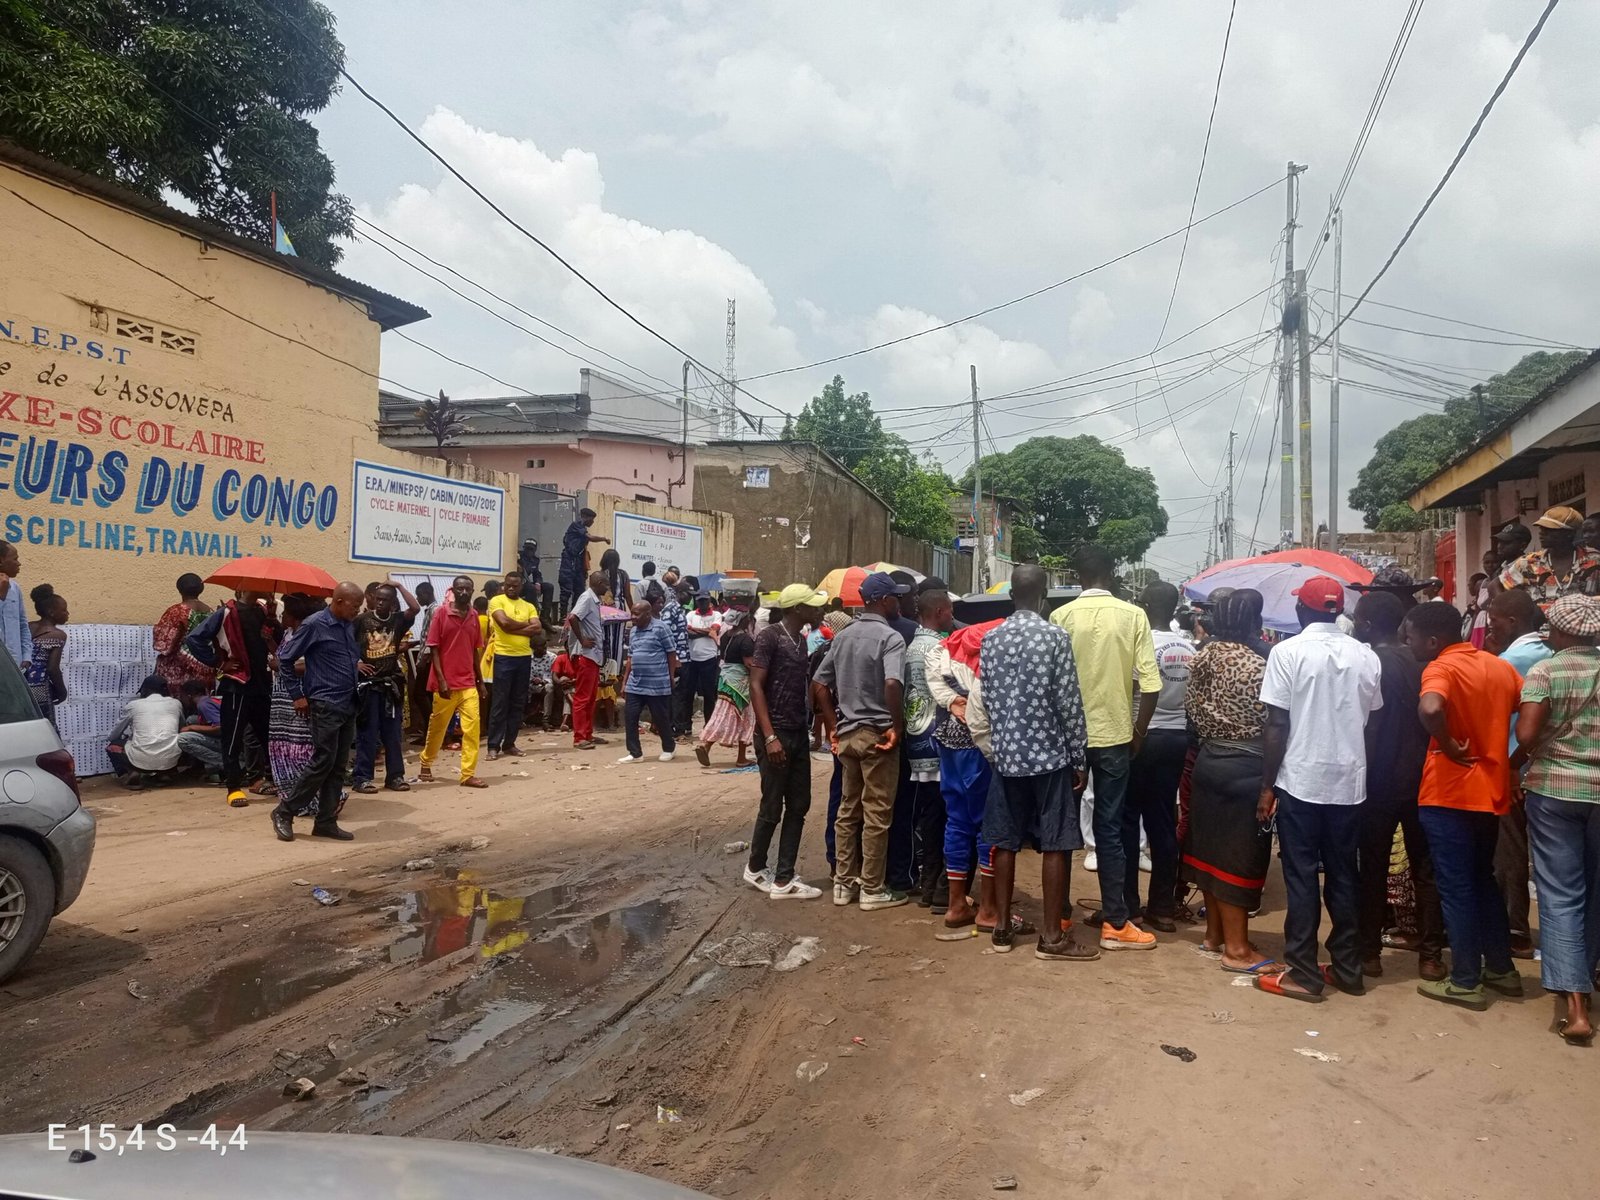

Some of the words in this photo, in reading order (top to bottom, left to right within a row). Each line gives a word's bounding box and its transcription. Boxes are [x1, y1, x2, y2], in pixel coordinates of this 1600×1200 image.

[37, 363, 68, 387] de
[134, 456, 205, 517] DU
[212, 468, 338, 532] CONGO
[370, 497, 394, 511] CYCLE
[397, 502, 431, 518] MATERNEL
[439, 508, 460, 522] CYCLE
[462, 513, 490, 527] PRIMAIRE
